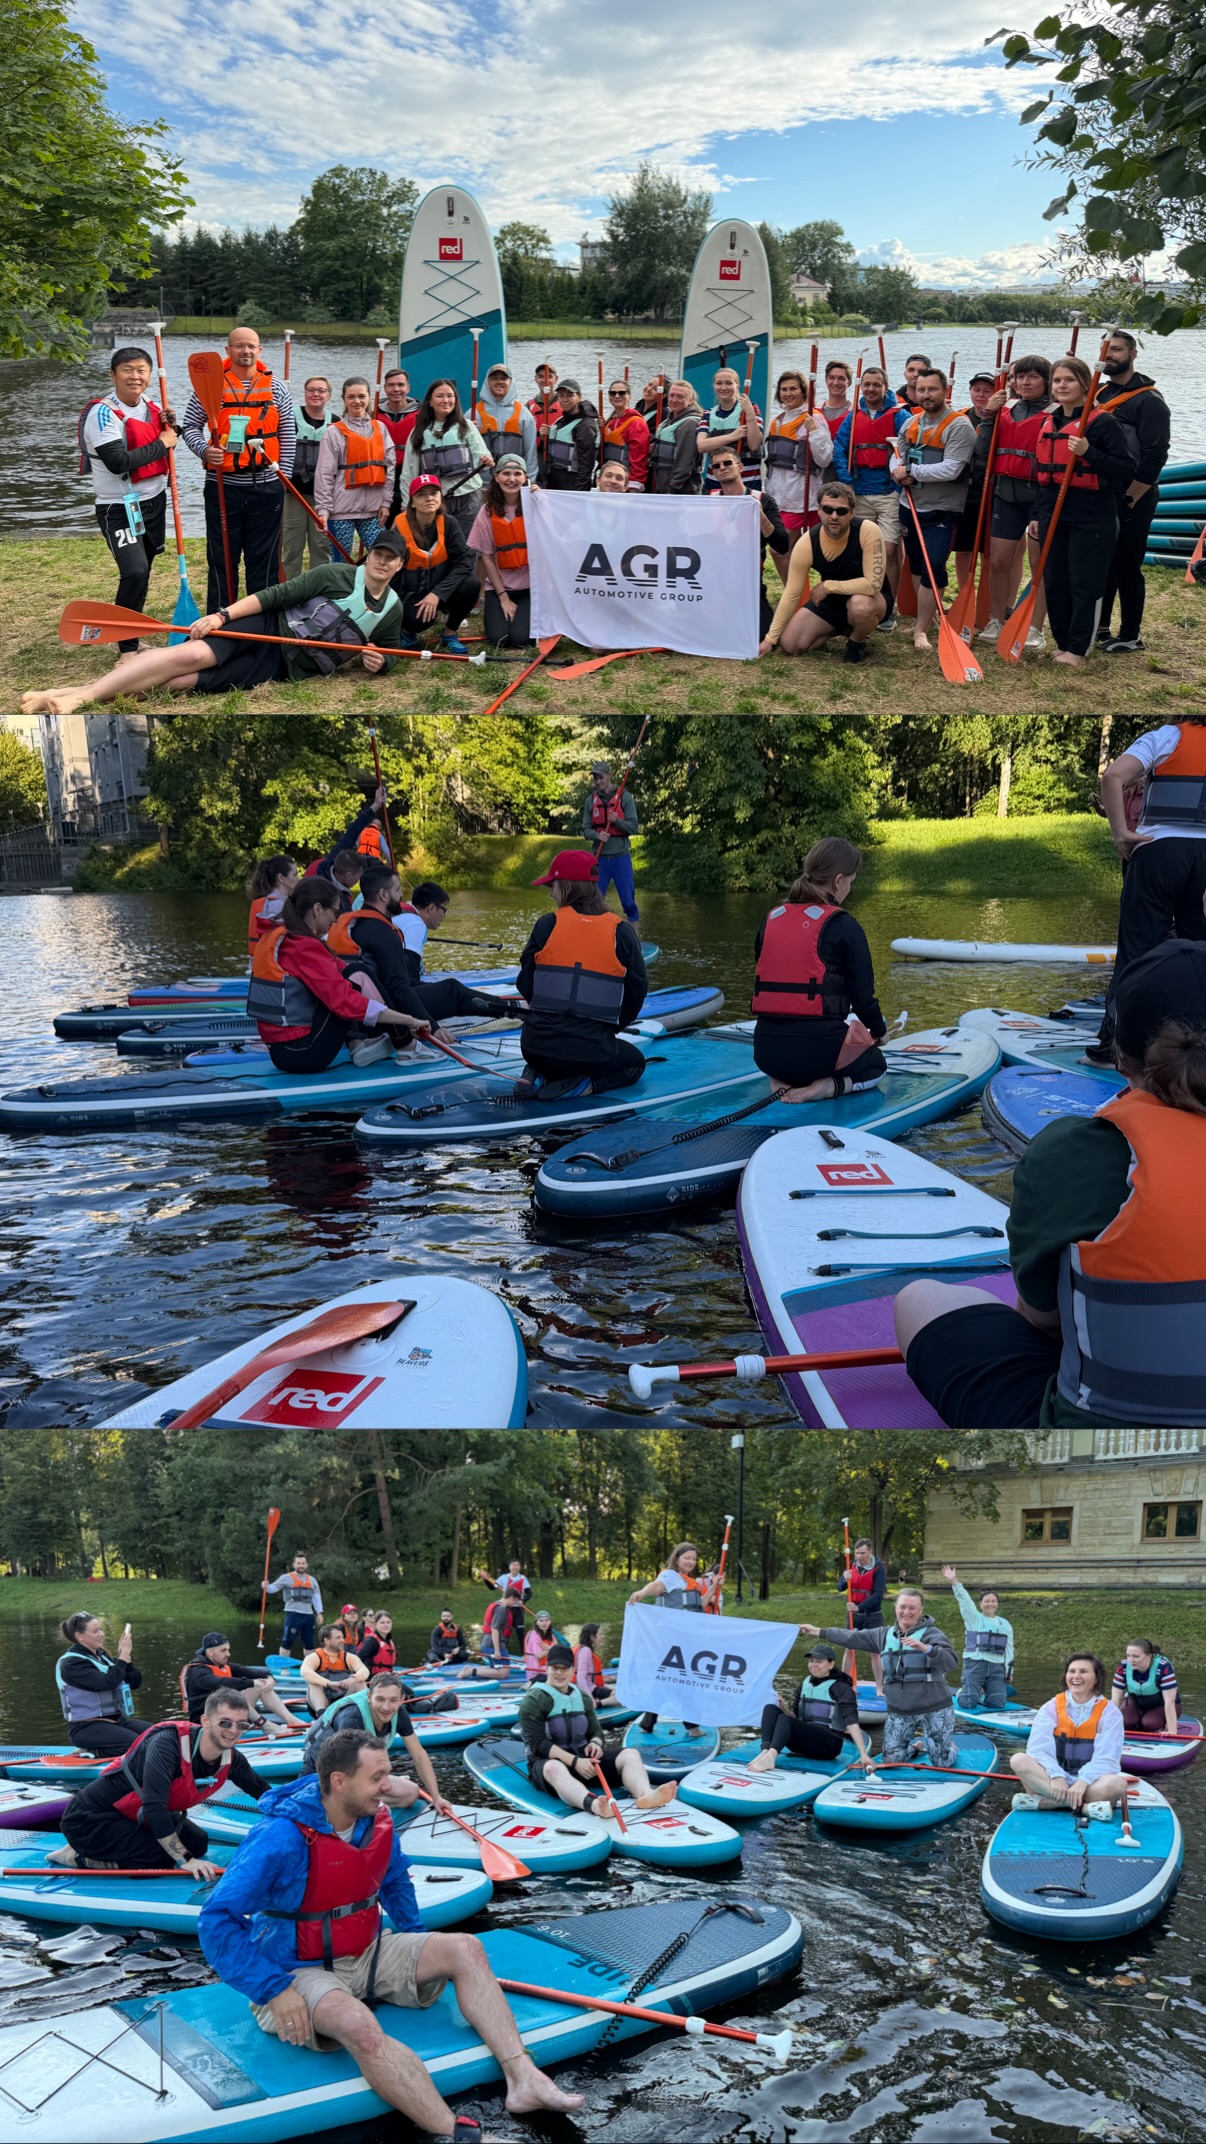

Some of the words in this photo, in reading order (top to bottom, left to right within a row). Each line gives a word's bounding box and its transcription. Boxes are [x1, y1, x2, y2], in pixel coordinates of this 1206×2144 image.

[441, 238, 461, 254] red
[721, 260, 740, 275] red
[420, 474, 431, 484] H
[575, 543, 703, 590] AGR
[574, 587, 654, 600] AUTOMOTIVE
[660, 592, 704, 602] GROUP
[827, 1163, 882, 1180] red
[681, 1183, 699, 1193] RIDE
[267, 1374, 377, 1413] red
[657, 1645, 747, 1686] AGR
[655, 1675, 711, 1689] AUTOMOTIVE
[713, 1684, 745, 1695] GROUP
